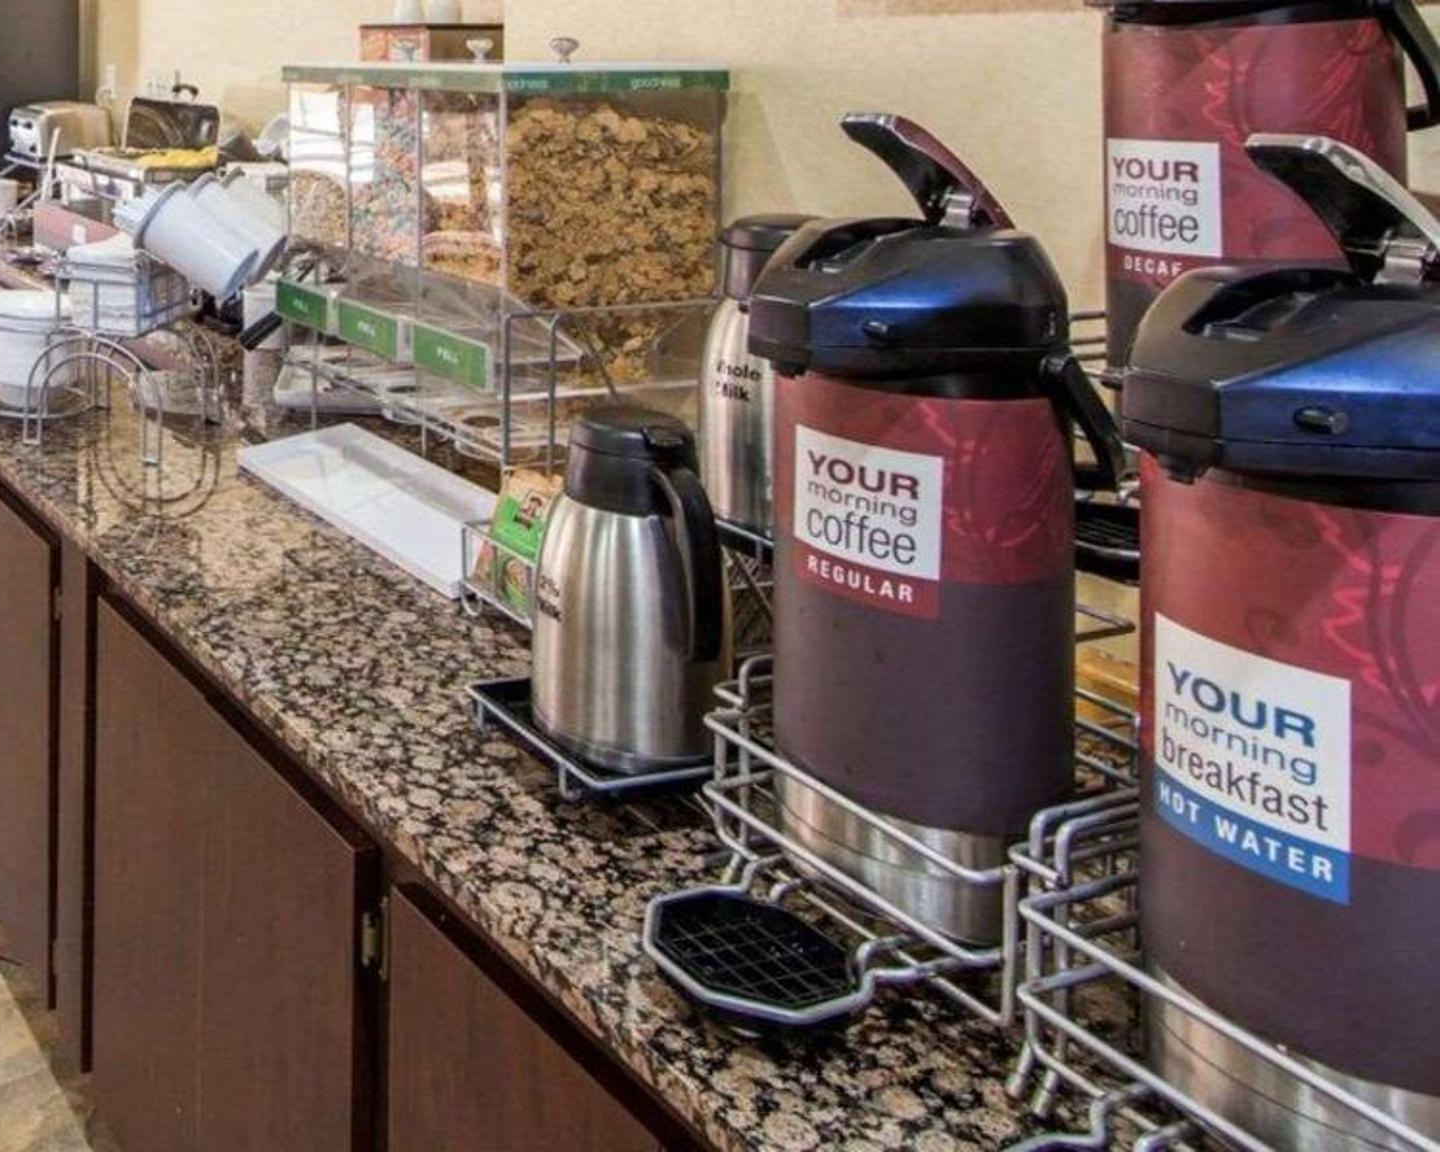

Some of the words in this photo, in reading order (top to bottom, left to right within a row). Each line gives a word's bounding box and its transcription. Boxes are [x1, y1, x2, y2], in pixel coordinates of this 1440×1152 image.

[1113, 157, 1199, 183] YOUR
[1113, 183, 1198, 207] morning
[1113, 204, 1199, 243] coffee
[1123, 255, 1184, 277] DECAF
[807, 448, 921, 500] YOUR
[807, 479, 918, 528] morning
[806, 507, 917, 566] coffee
[806, 554, 914, 603] REGULAR
[1167, 660, 1316, 748] YOUR
[1164, 701, 1318, 787] morning
[1162, 724, 1329, 832] breakfast
[1159, 781, 1202, 825] HOT
[1213, 814, 1334, 883] WATER
